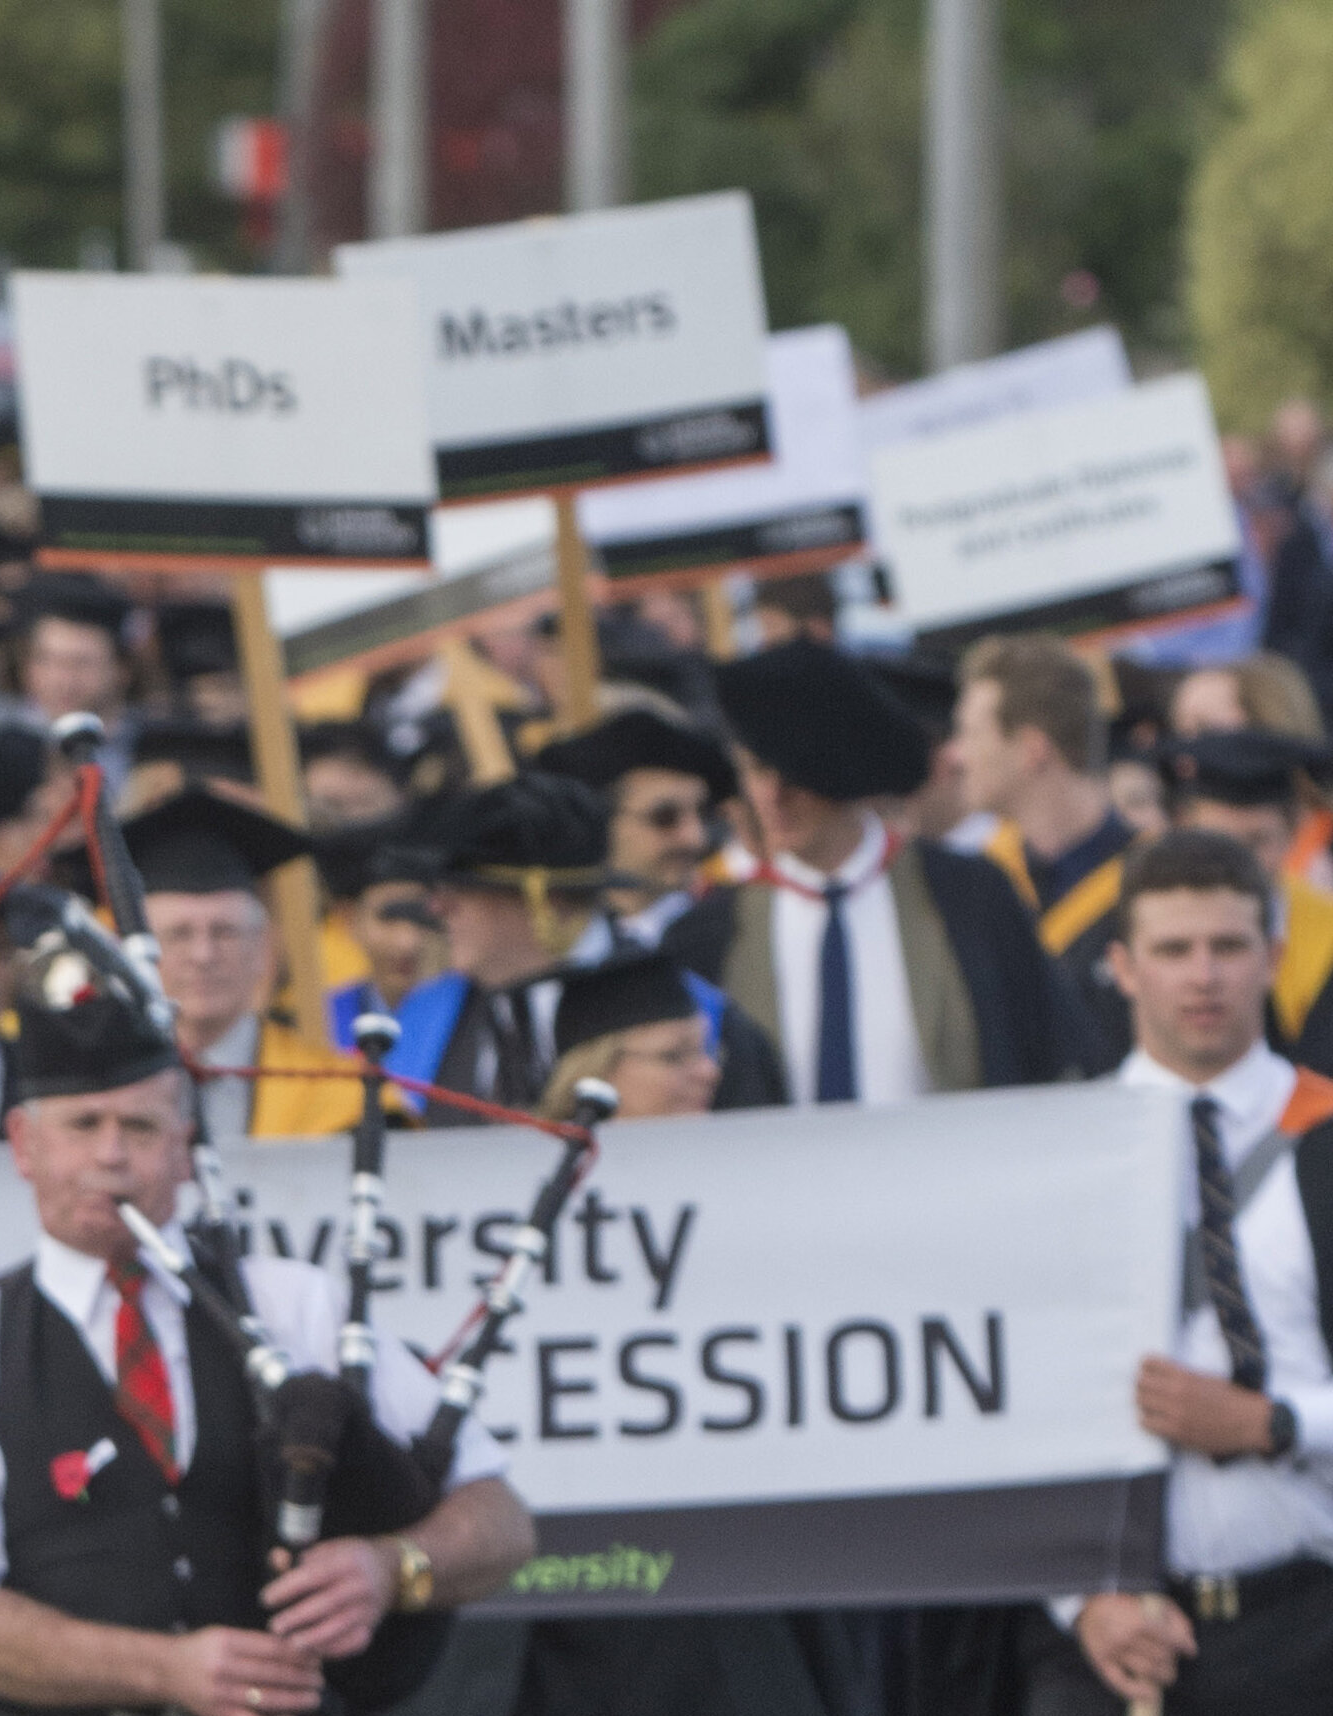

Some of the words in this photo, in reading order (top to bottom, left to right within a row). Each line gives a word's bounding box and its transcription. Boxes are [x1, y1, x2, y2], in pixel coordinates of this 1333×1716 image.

[438, 294, 676, 362] Masters
[143, 357, 298, 412] PhDs
[405, 1311, 1007, 1444] ESSION
